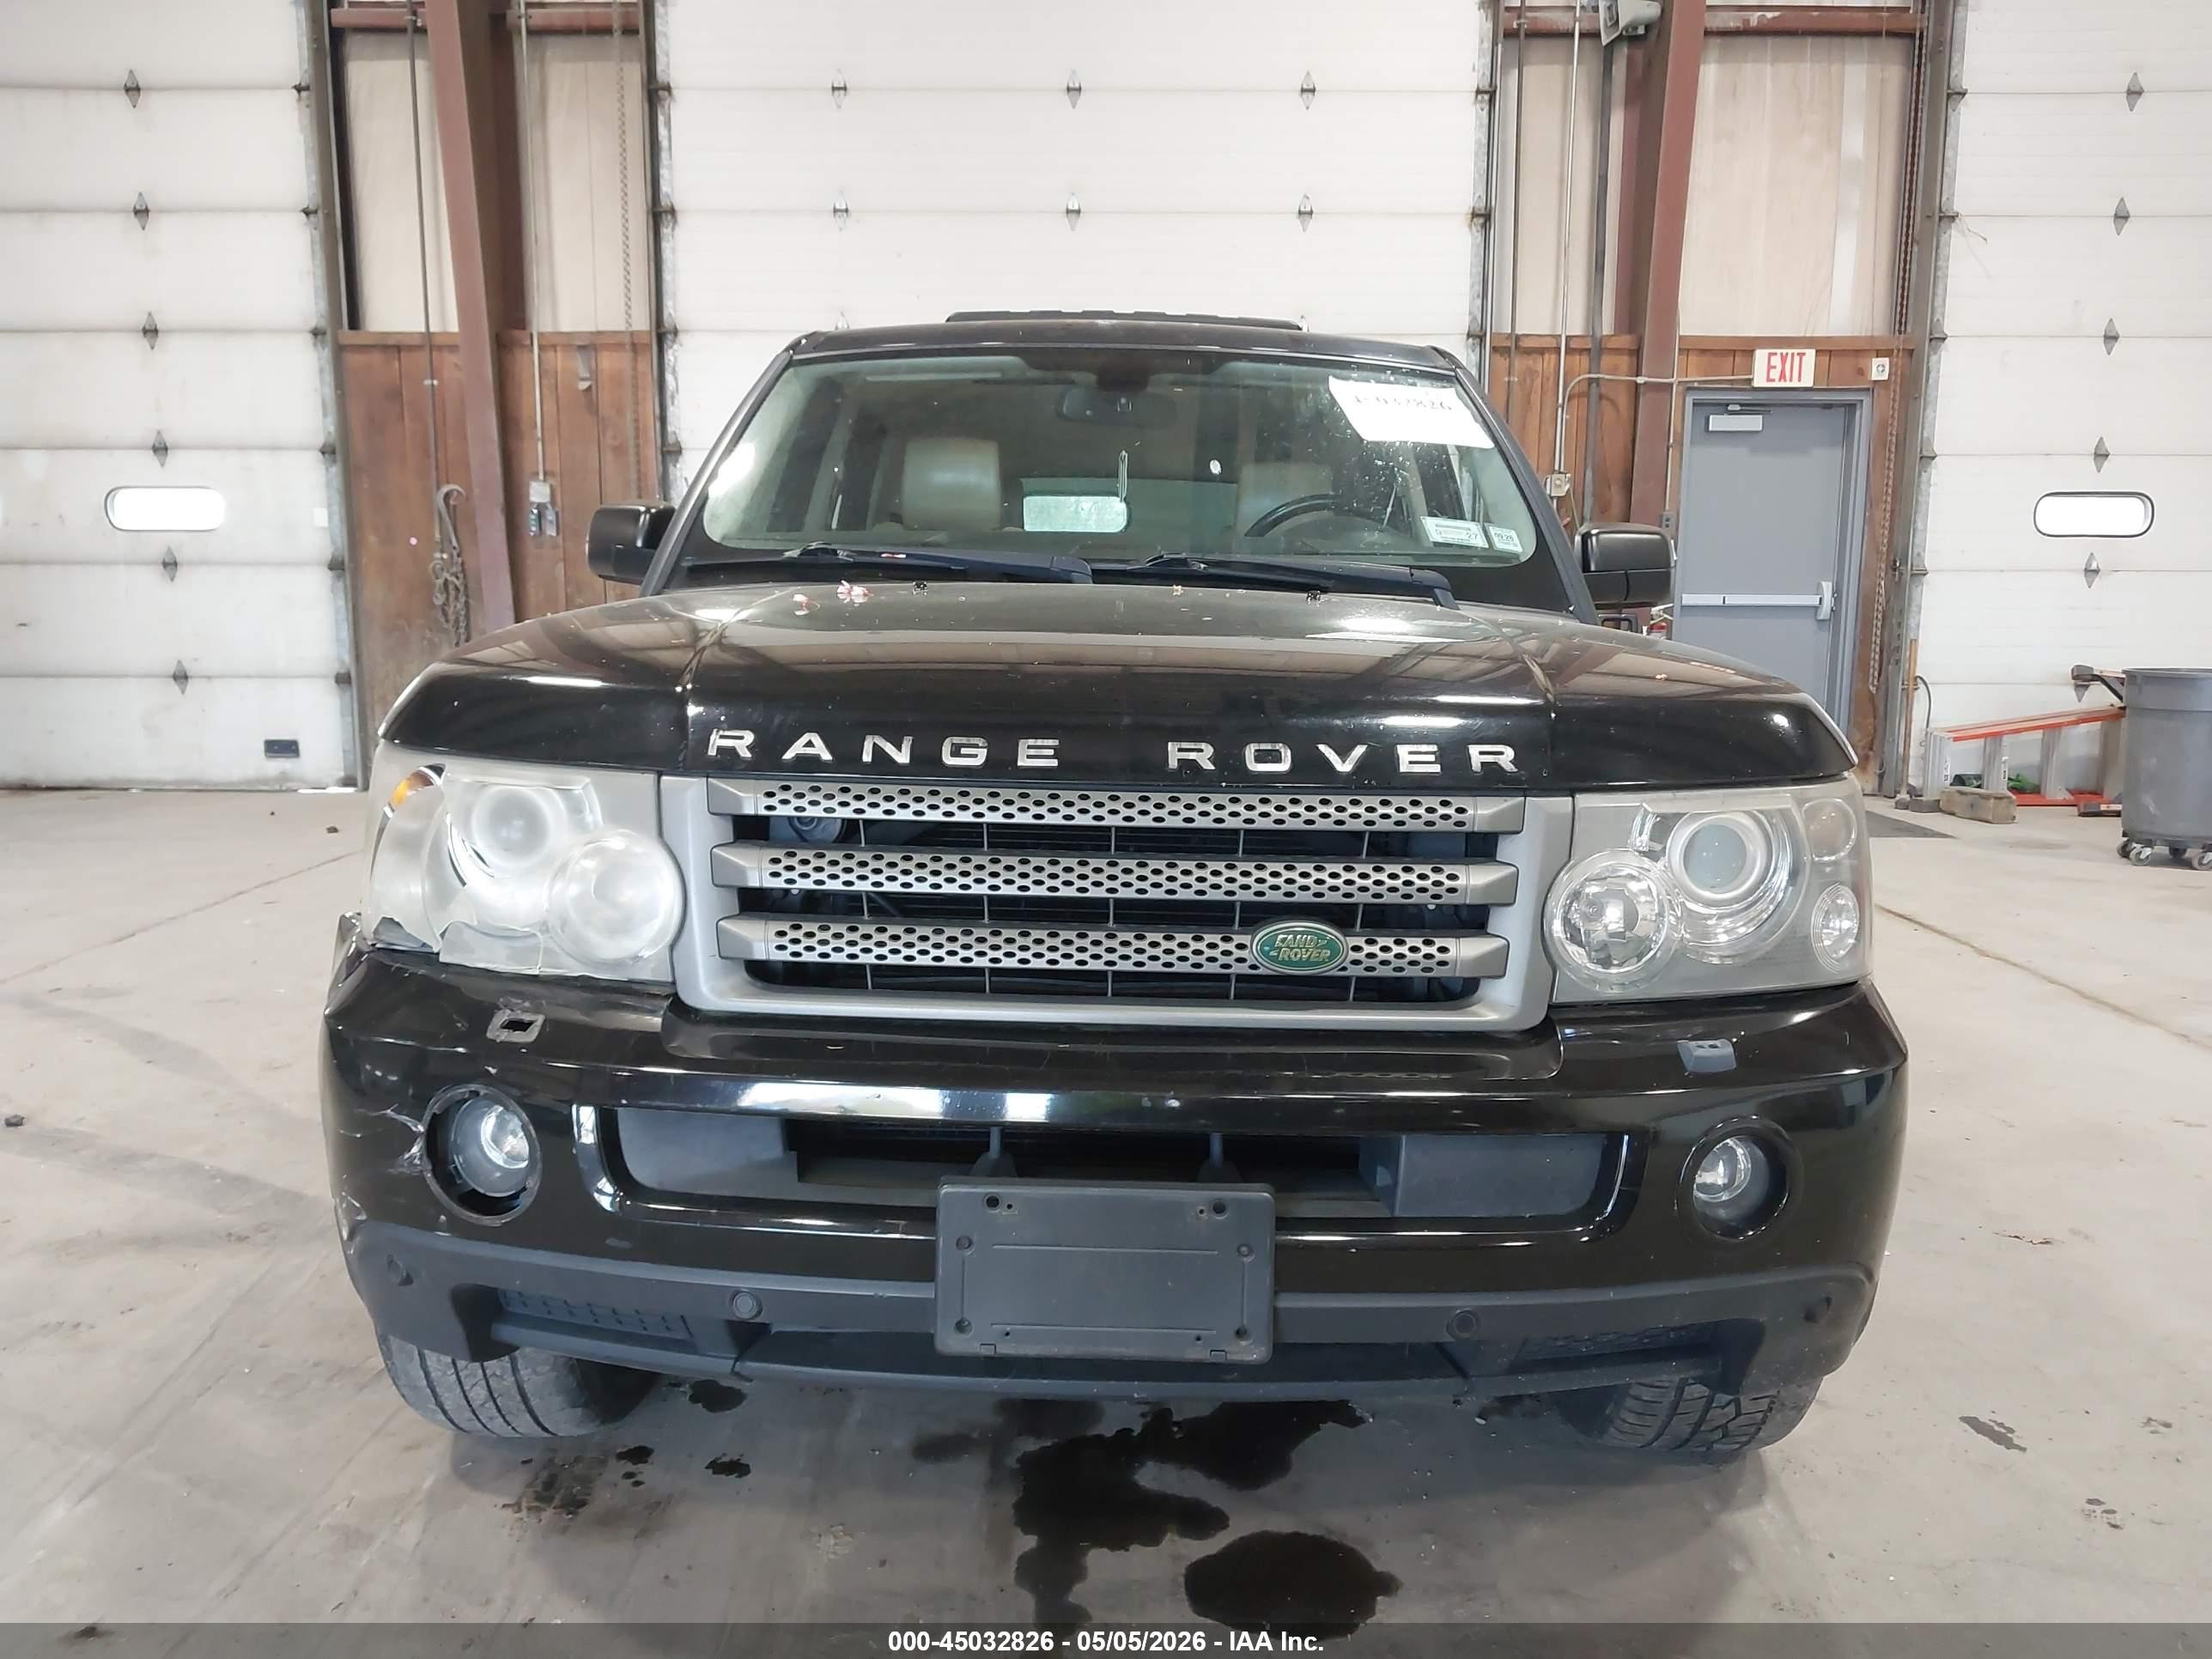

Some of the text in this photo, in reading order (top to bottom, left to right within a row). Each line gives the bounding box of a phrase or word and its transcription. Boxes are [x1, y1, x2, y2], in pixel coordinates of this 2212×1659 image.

[1765, 352, 1806, 383] EXIT
[707, 728, 1520, 774] RANGE ROVER
[1274, 934, 1317, 948] LAND
[1278, 947, 1331, 962] ROVER
